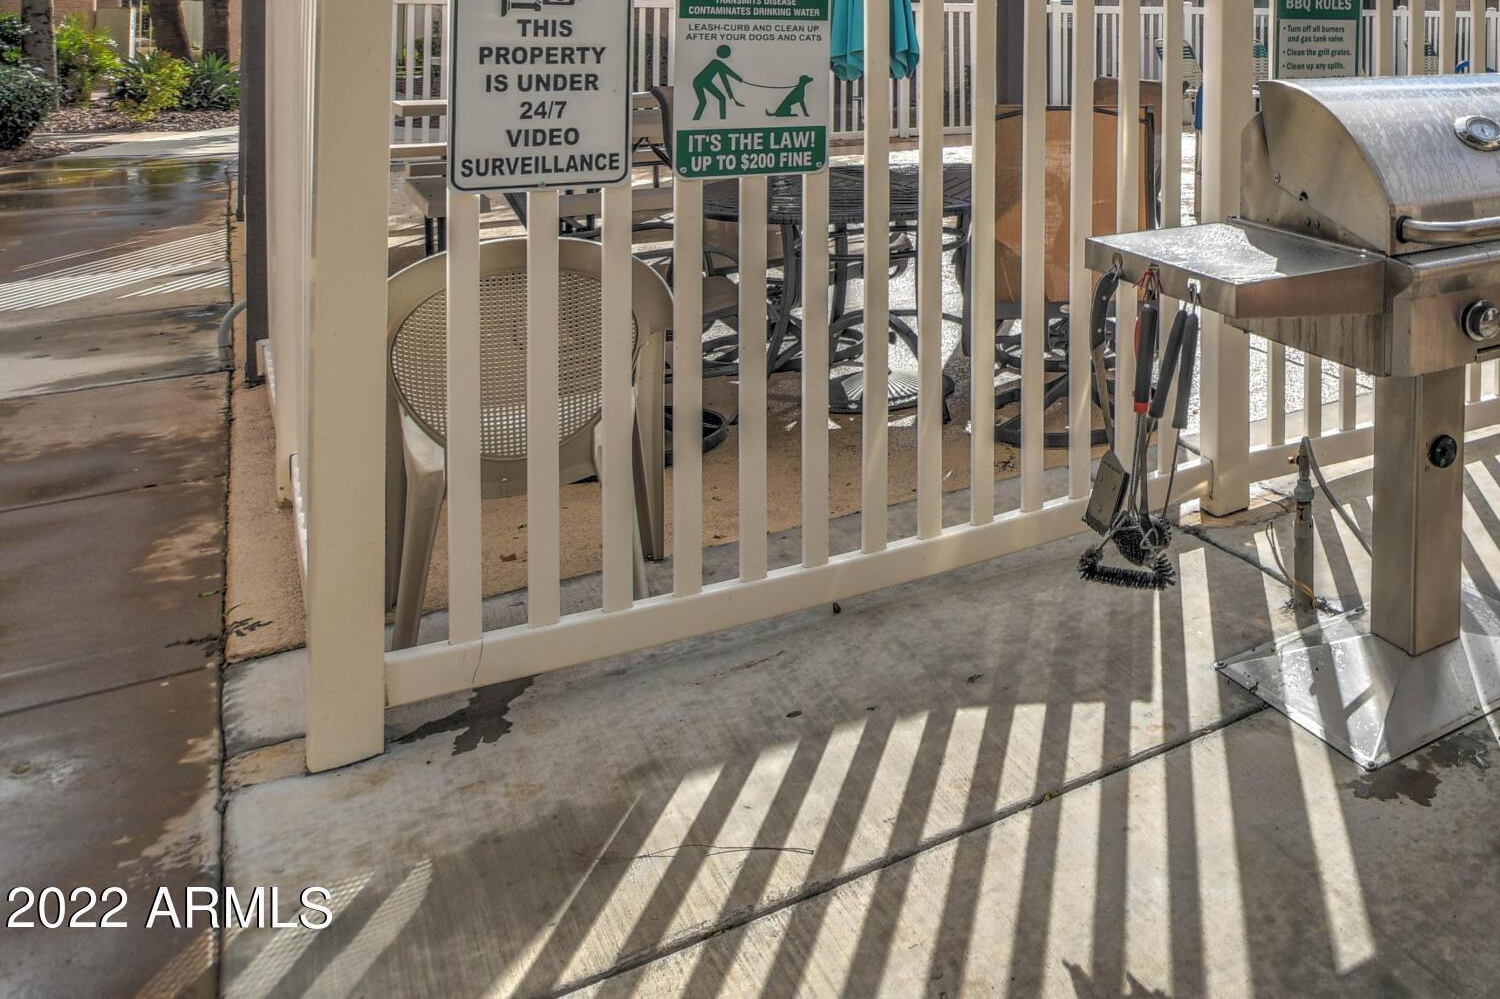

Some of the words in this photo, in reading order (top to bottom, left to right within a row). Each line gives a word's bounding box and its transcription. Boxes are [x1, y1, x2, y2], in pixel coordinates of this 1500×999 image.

[688, 6, 751, 16] CONTAMINATES
[752, 7, 791, 17] DRINKING
[793, 7, 820, 17] WATER
[517, 19, 573, 38] THIS
[685, 33, 717, 41] AFTER
[719, 33, 746, 41] YOUR
[749, 33, 775, 41] DOGS
[777, 33, 797, 41] AND
[799, 33, 823, 42] CATS
[688, 23, 750, 32] LEASH-CURB
[752, 24, 772, 32] AND
[774, 24, 805, 33] CLEAN
[807, 25, 820, 33] UP
[1287, 24, 1301, 33] Turn
[1302, 24, 1312, 33] off
[1312, 25, 1320, 33] all
[1321, 25, 1345, 33] burners
[1287, 35, 1300, 43] and
[1300, 36, 1312, 44] gas
[1312, 35, 1327, 43] tank
[478, 46, 606, 65] PROPERTY
[1286, 48, 1305, 56] Clean
[1306, 48, 1317, 56] the
[1317, 48, 1330, 57] grill
[1286, 62, 1305, 70] Clean
[1306, 63, 1314, 71] up
[1315, 63, 1326, 71] any
[485, 74, 508, 93] IS
[517, 73, 599, 92] UNDER
[519, 101, 567, 120] 24/7
[506, 127, 580, 148] VIDEO
[688, 134, 722, 153] IT'S
[728, 132, 764, 152] THE
[770, 130, 816, 150] LAW!
[460, 152, 620, 178] SURVEILLANCE
[691, 155, 713, 172] UP
[716, 154, 737, 171] TO
[740, 153, 775, 171] $200
[779, 151, 812, 167] FINE
